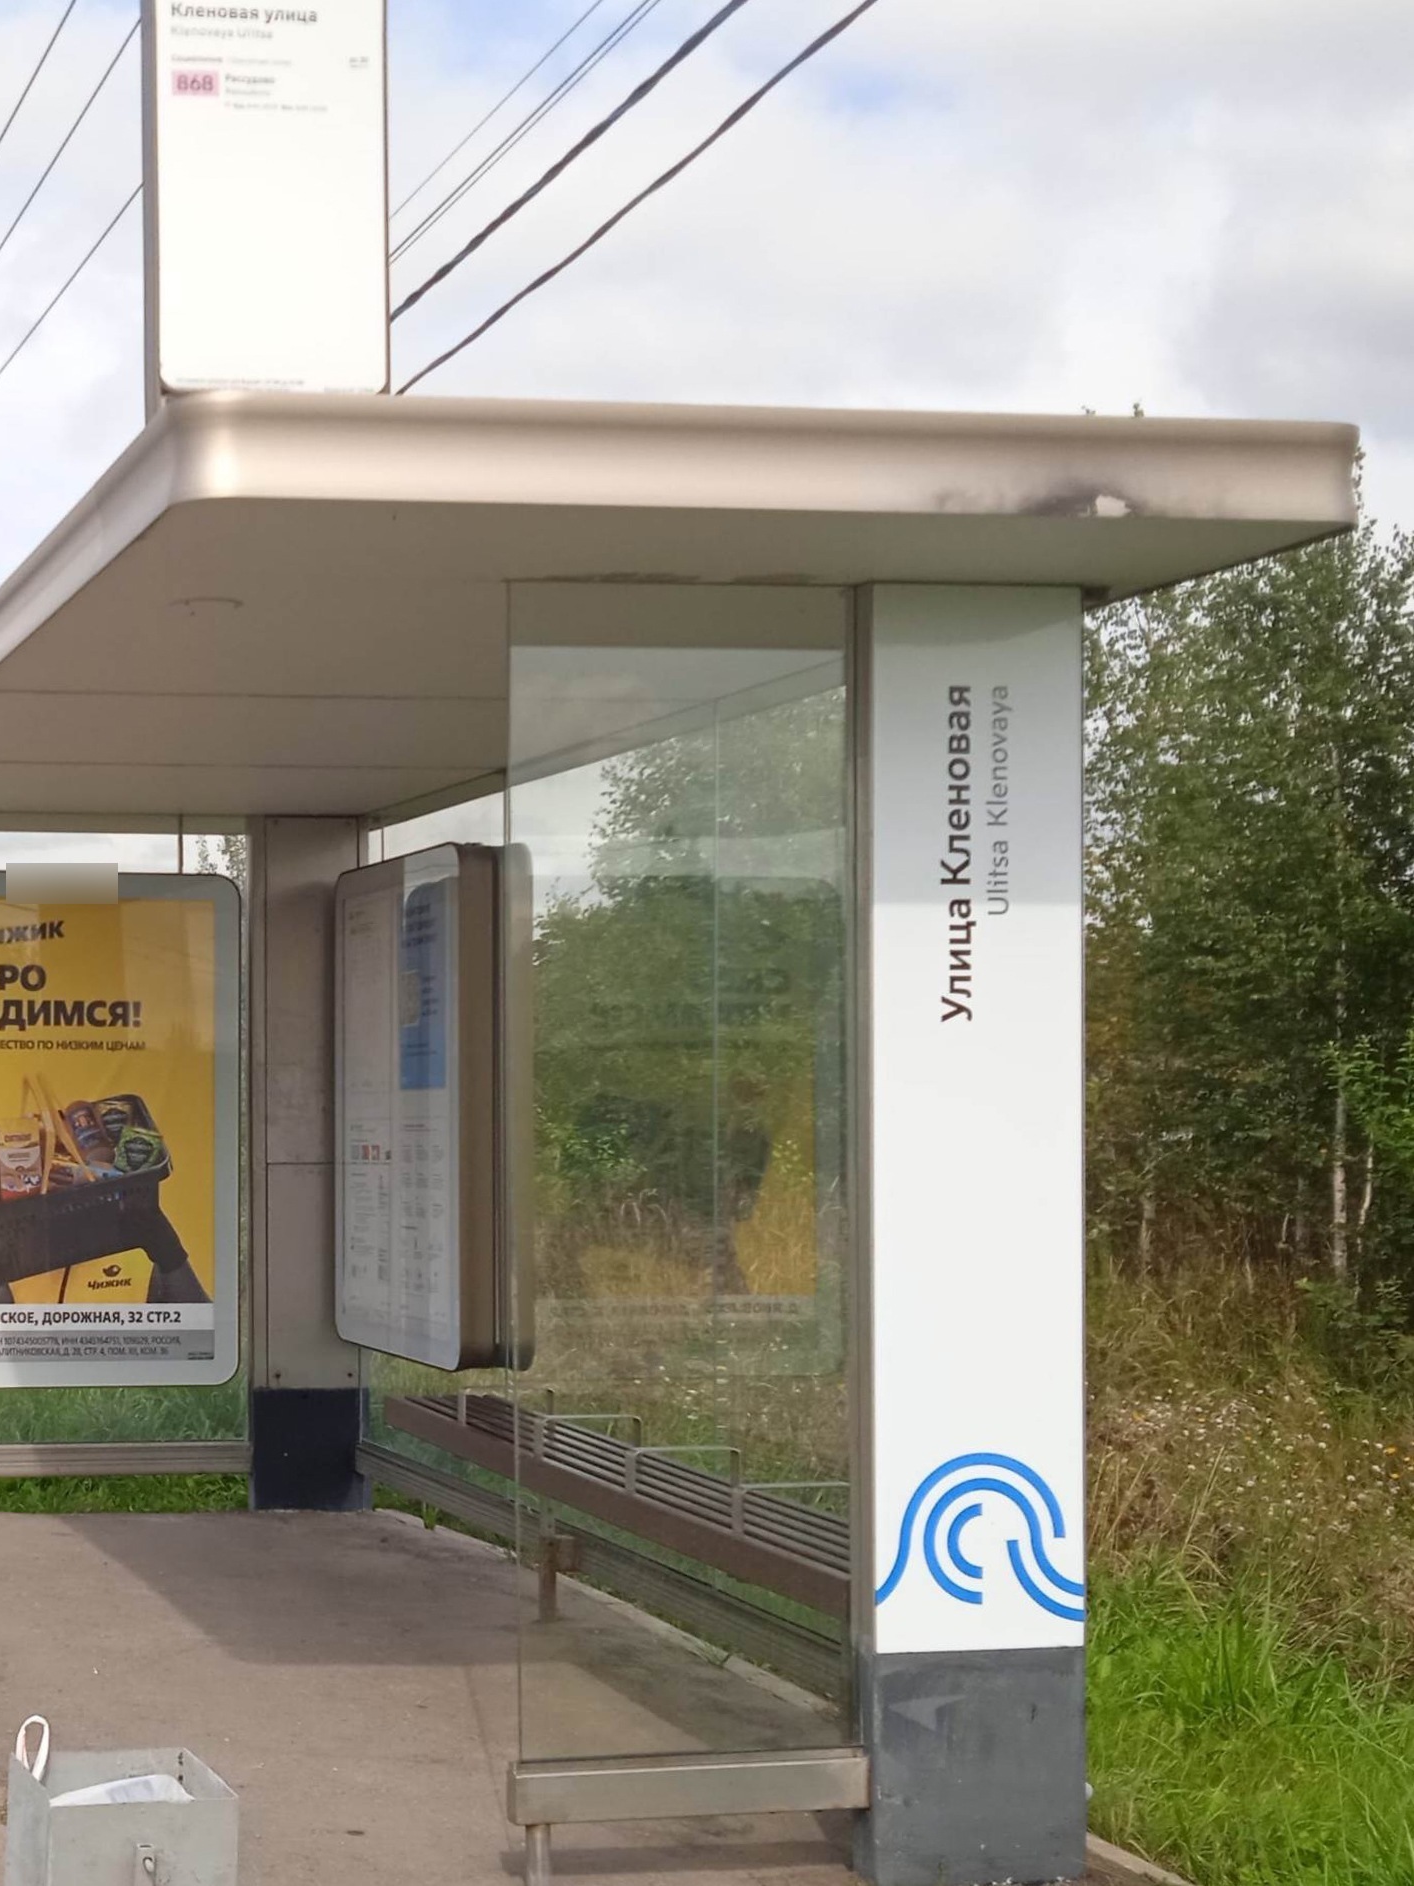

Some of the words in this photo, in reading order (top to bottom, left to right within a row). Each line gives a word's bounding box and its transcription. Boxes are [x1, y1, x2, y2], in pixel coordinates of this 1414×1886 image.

[170, 2, 260, 20] Кленовая
[264, 9, 318, 24] улица
[177, 74, 214, 91] 868
[986, 685, 1012, 827] Klenovaya
[940, 685, 972, 886] Кленовая
[986, 839, 1010, 916] Ulitsa
[940, 898, 977, 1023] Улица
[36, 1040, 54, 1050] ПО
[56, 1040, 104, 1051] НИЗКИМ
[42, 1311, 125, 1326] ДОРОЖНАЯ,
[127, 1311, 143, 1324] 32
[146, 1311, 182, 1324] СТР.2
